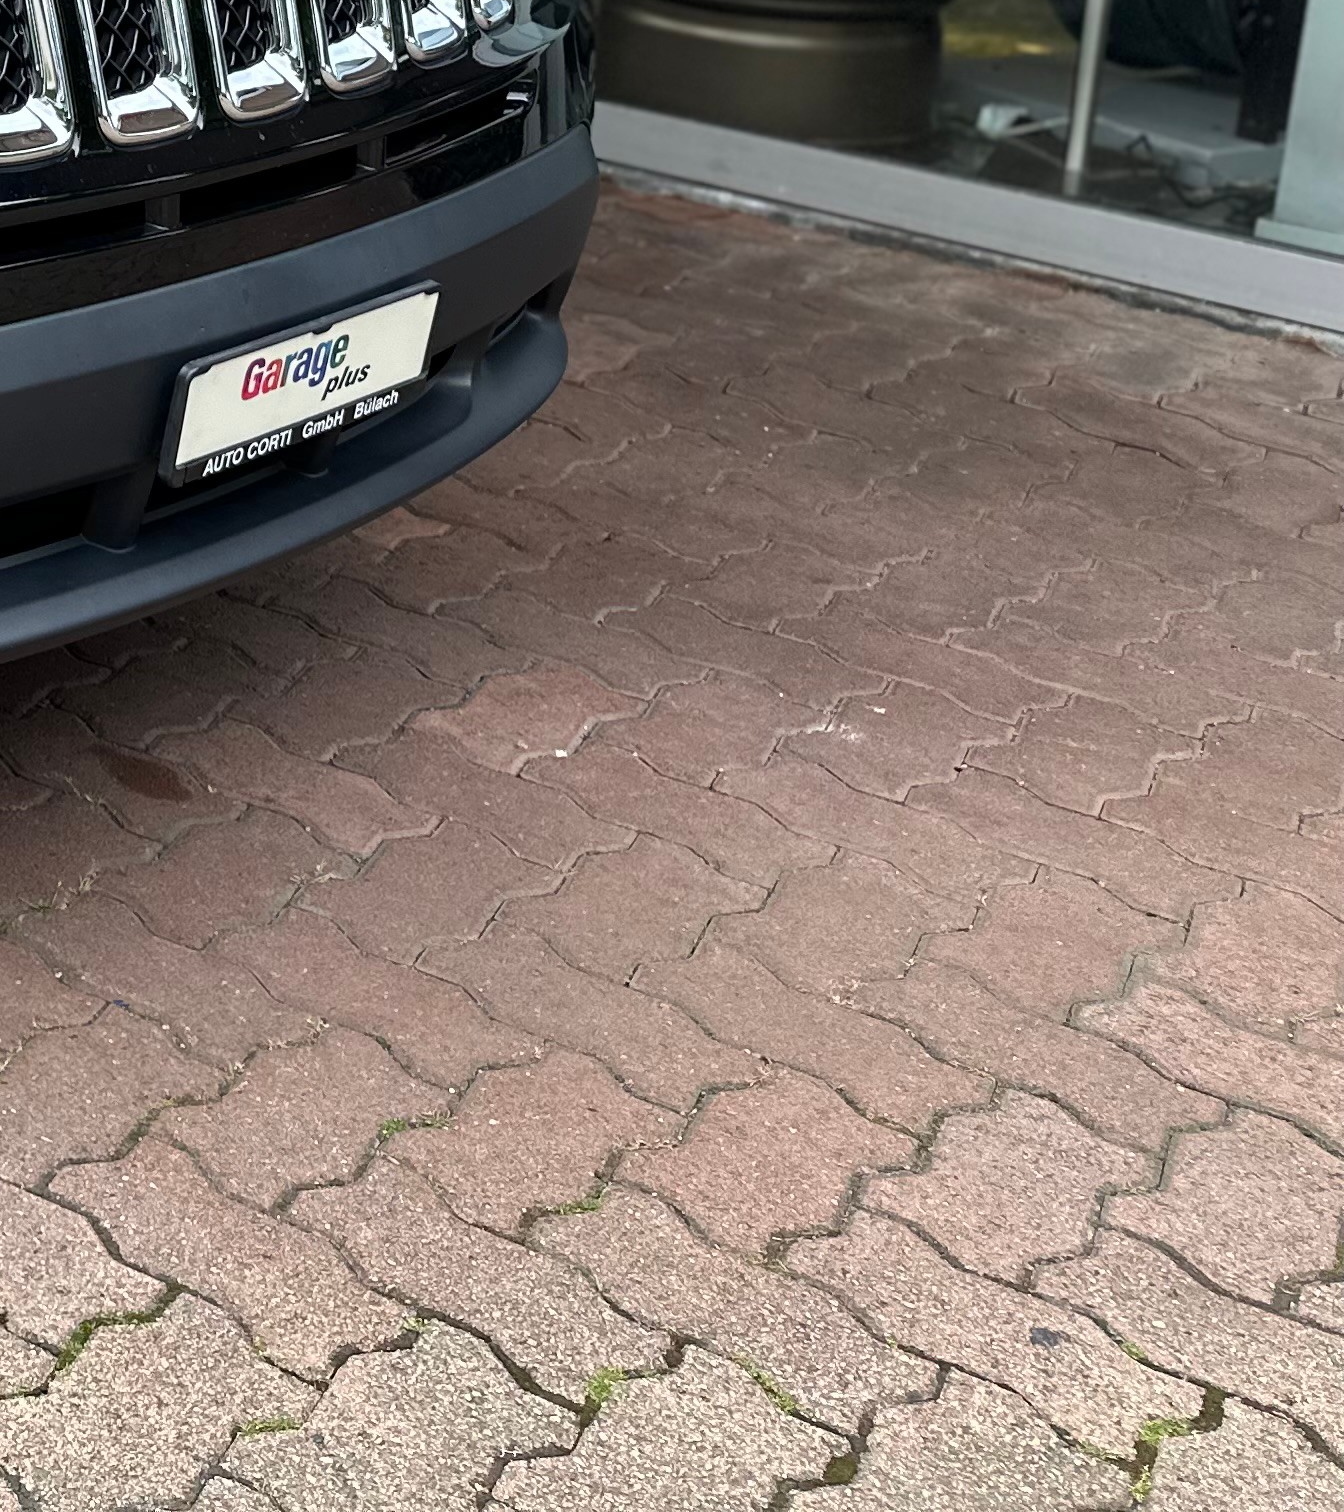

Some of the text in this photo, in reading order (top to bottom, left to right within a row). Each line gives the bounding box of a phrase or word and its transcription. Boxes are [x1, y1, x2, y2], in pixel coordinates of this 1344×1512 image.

[240, 333, 350, 402] Garage
[320, 362, 371, 402] plus
[202, 388, 400, 478] AUTO CORTI GmbH Bülach
